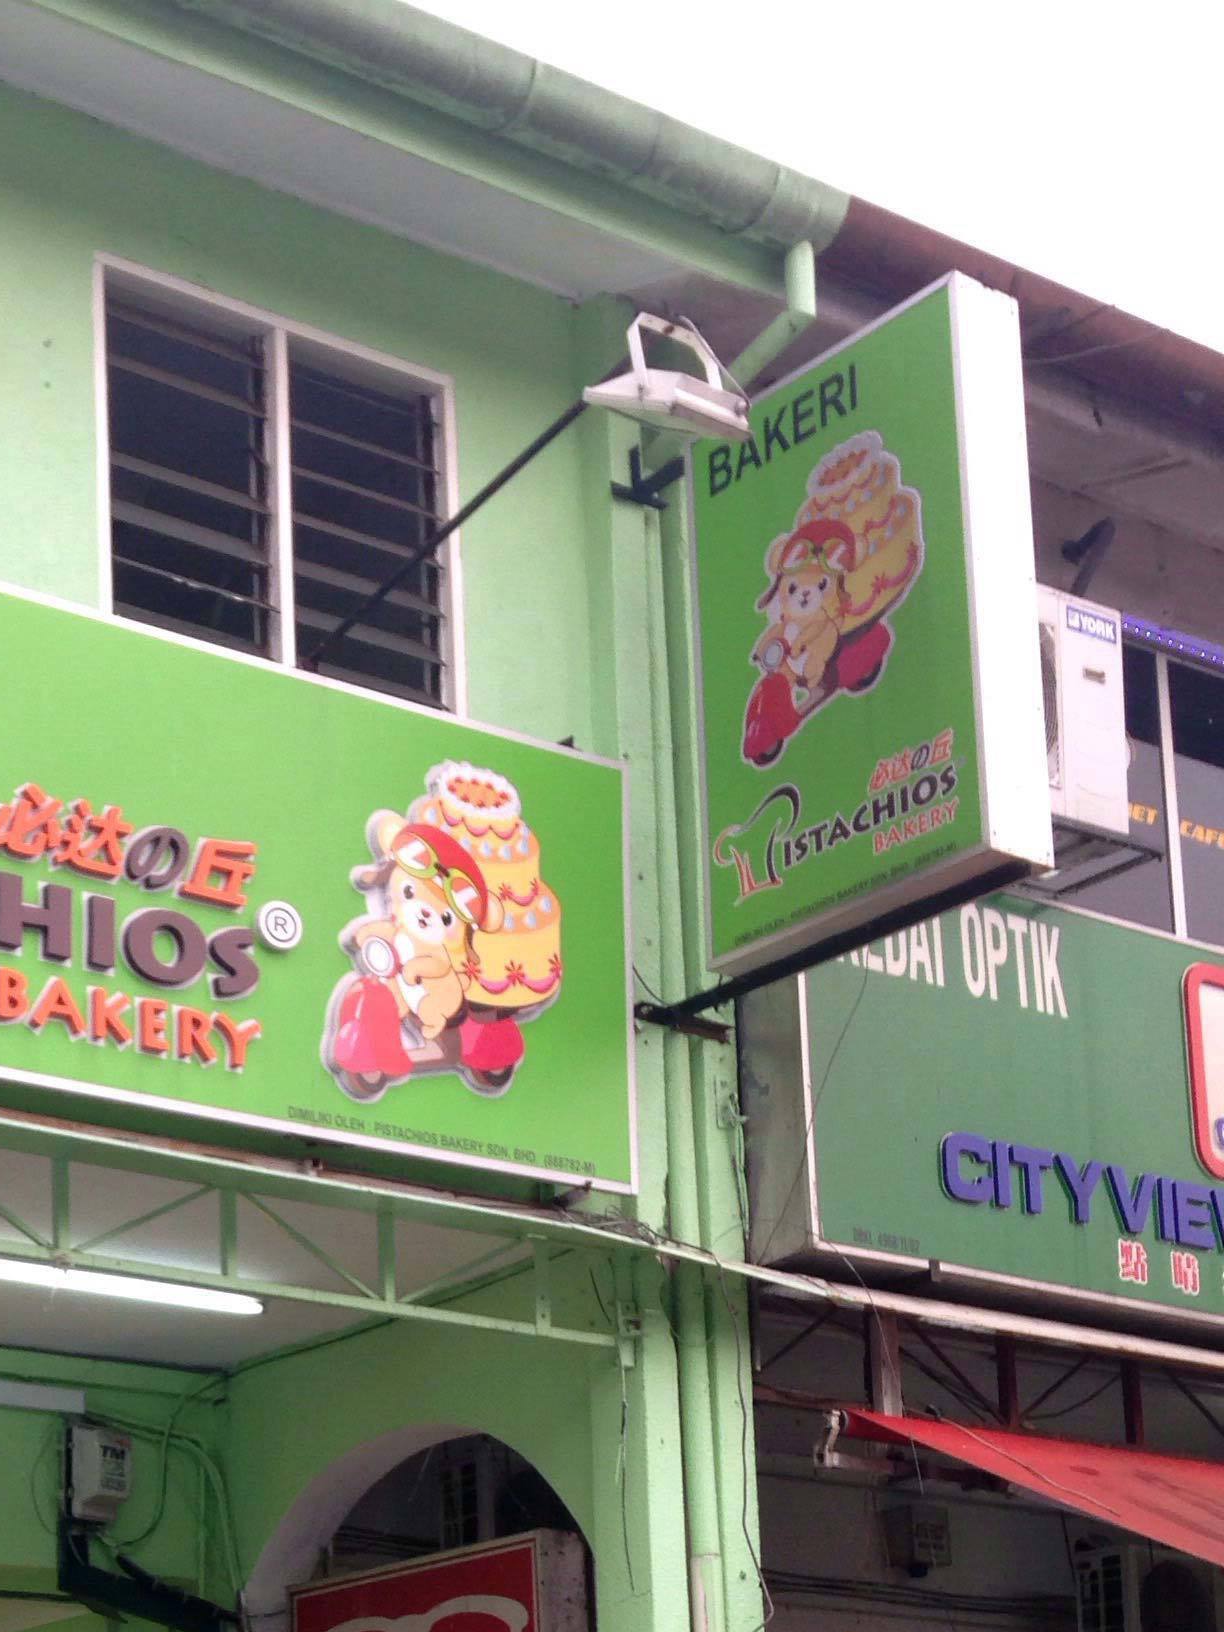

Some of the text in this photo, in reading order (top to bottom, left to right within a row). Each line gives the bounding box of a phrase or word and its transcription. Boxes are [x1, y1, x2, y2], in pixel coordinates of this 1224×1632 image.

[708, 363, 859, 497] BAKERI
[1079, 615, 1117, 640] YORK
[872, 796, 960, 856] BAKERY
[837, 902, 1069, 1019] DAI OPTIK
[374, 1121, 438, 1145] PISTACHIOS
[440, 1135, 484, 1153] BAKERY
